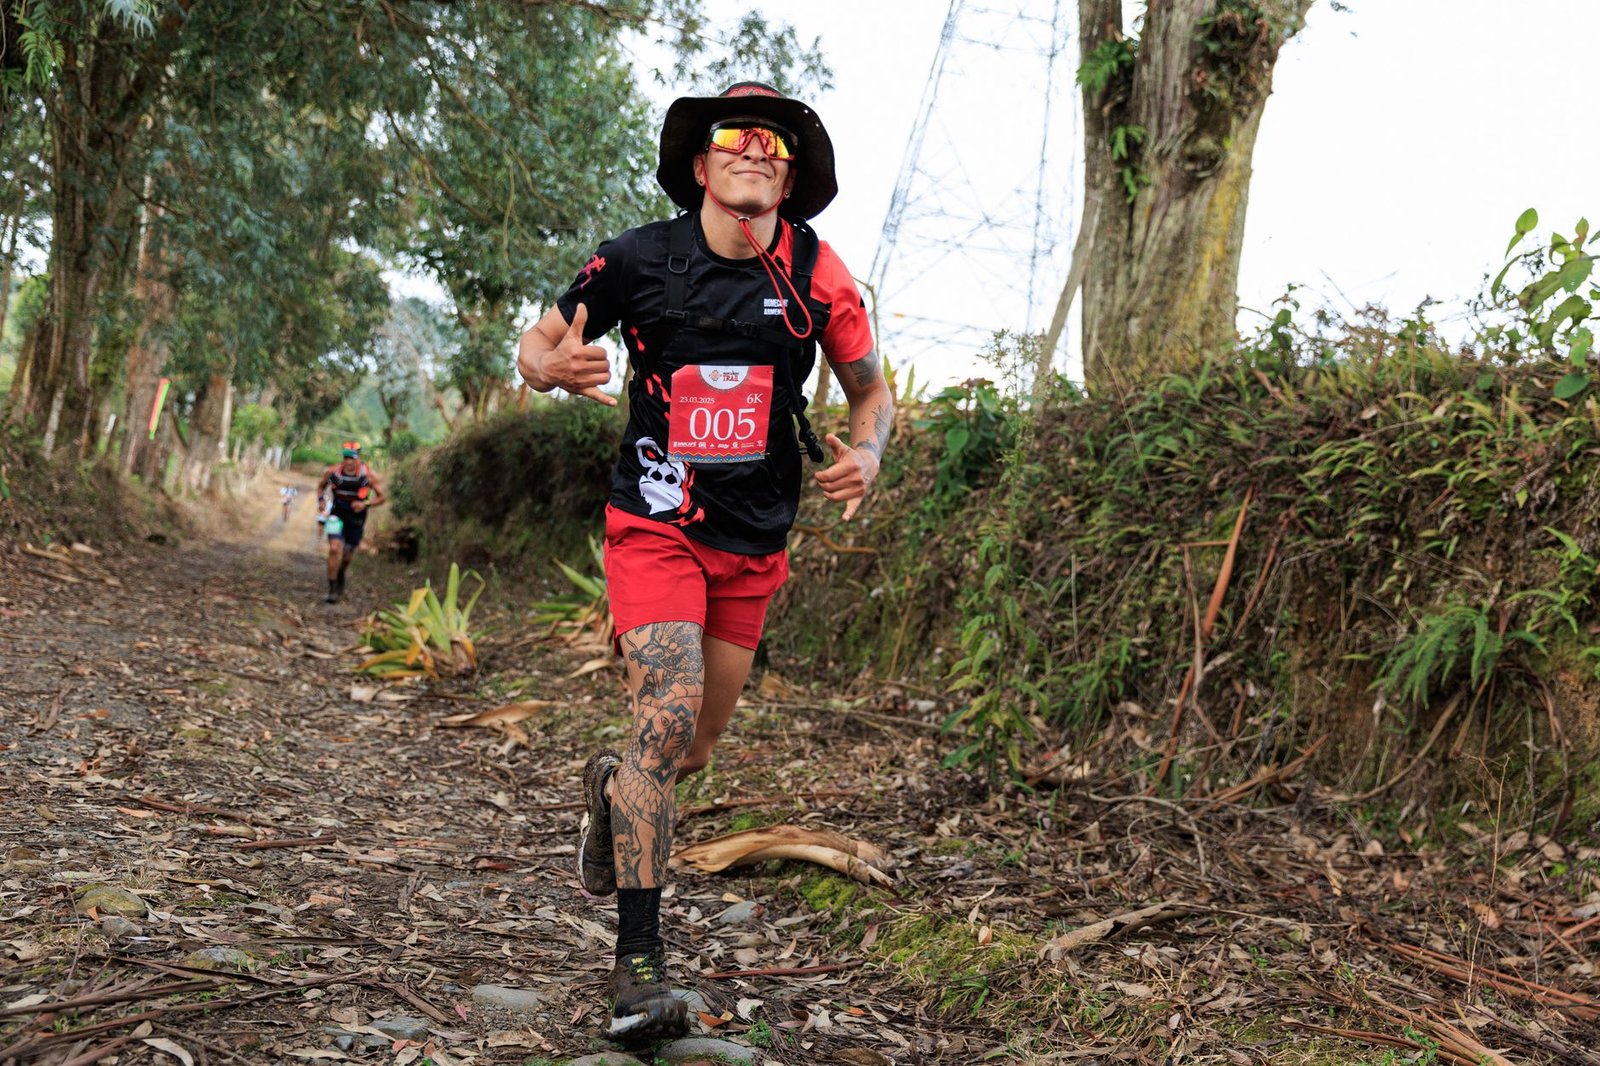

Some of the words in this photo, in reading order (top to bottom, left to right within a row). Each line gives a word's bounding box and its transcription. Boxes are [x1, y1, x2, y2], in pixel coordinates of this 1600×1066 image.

[679, 396, 715, 404] 23.03.2025
[746, 393, 763, 404] 6K
[689, 407, 756, 441] 005
